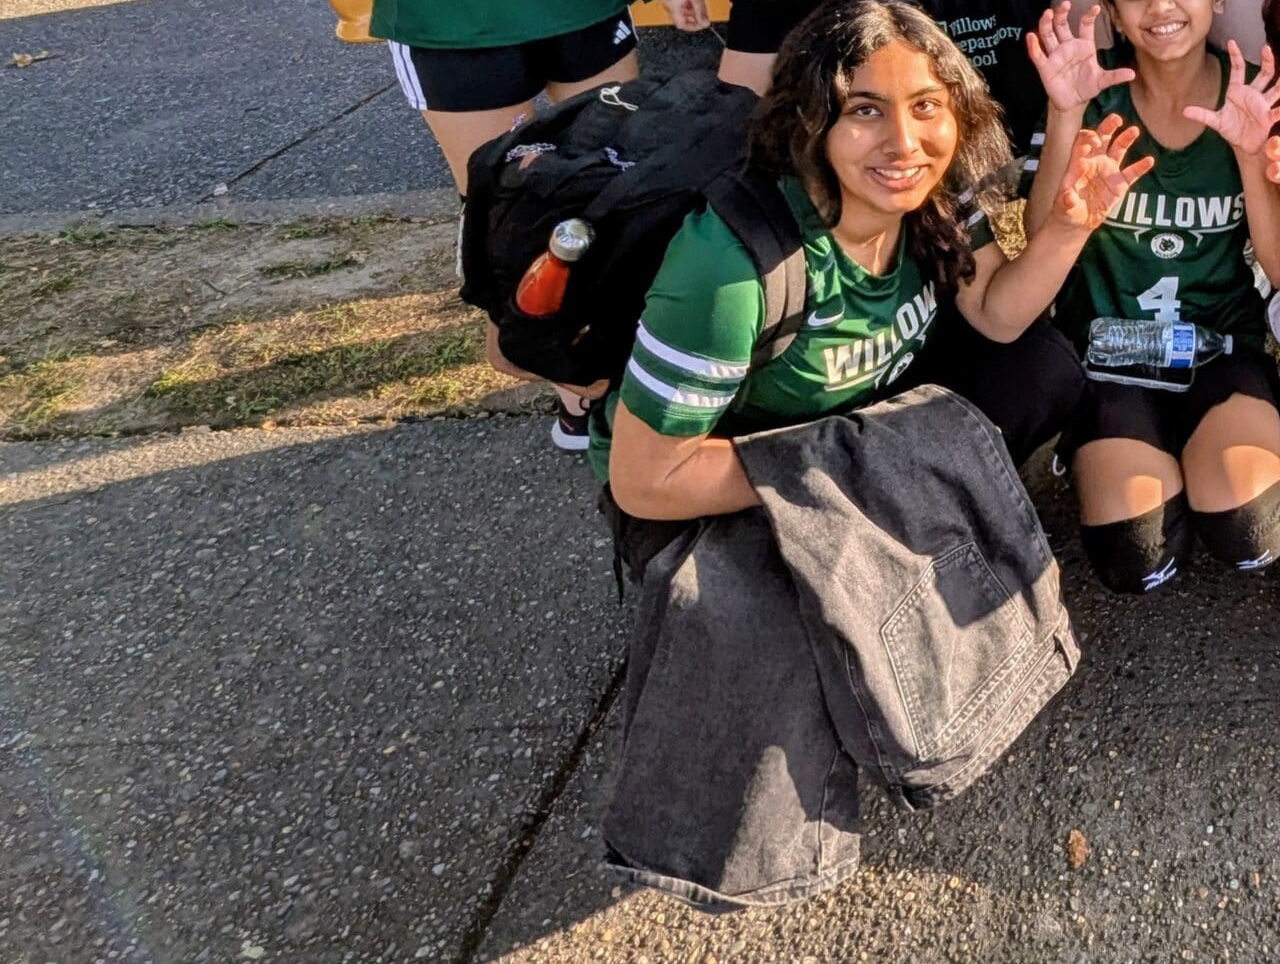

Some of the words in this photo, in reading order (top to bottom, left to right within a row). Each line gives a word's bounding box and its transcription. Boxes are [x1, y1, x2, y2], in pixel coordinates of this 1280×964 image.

[970, 50, 998, 67] ool
[1136, 276, 1182, 322] 4
[823, 280, 938, 384] WILLOW
